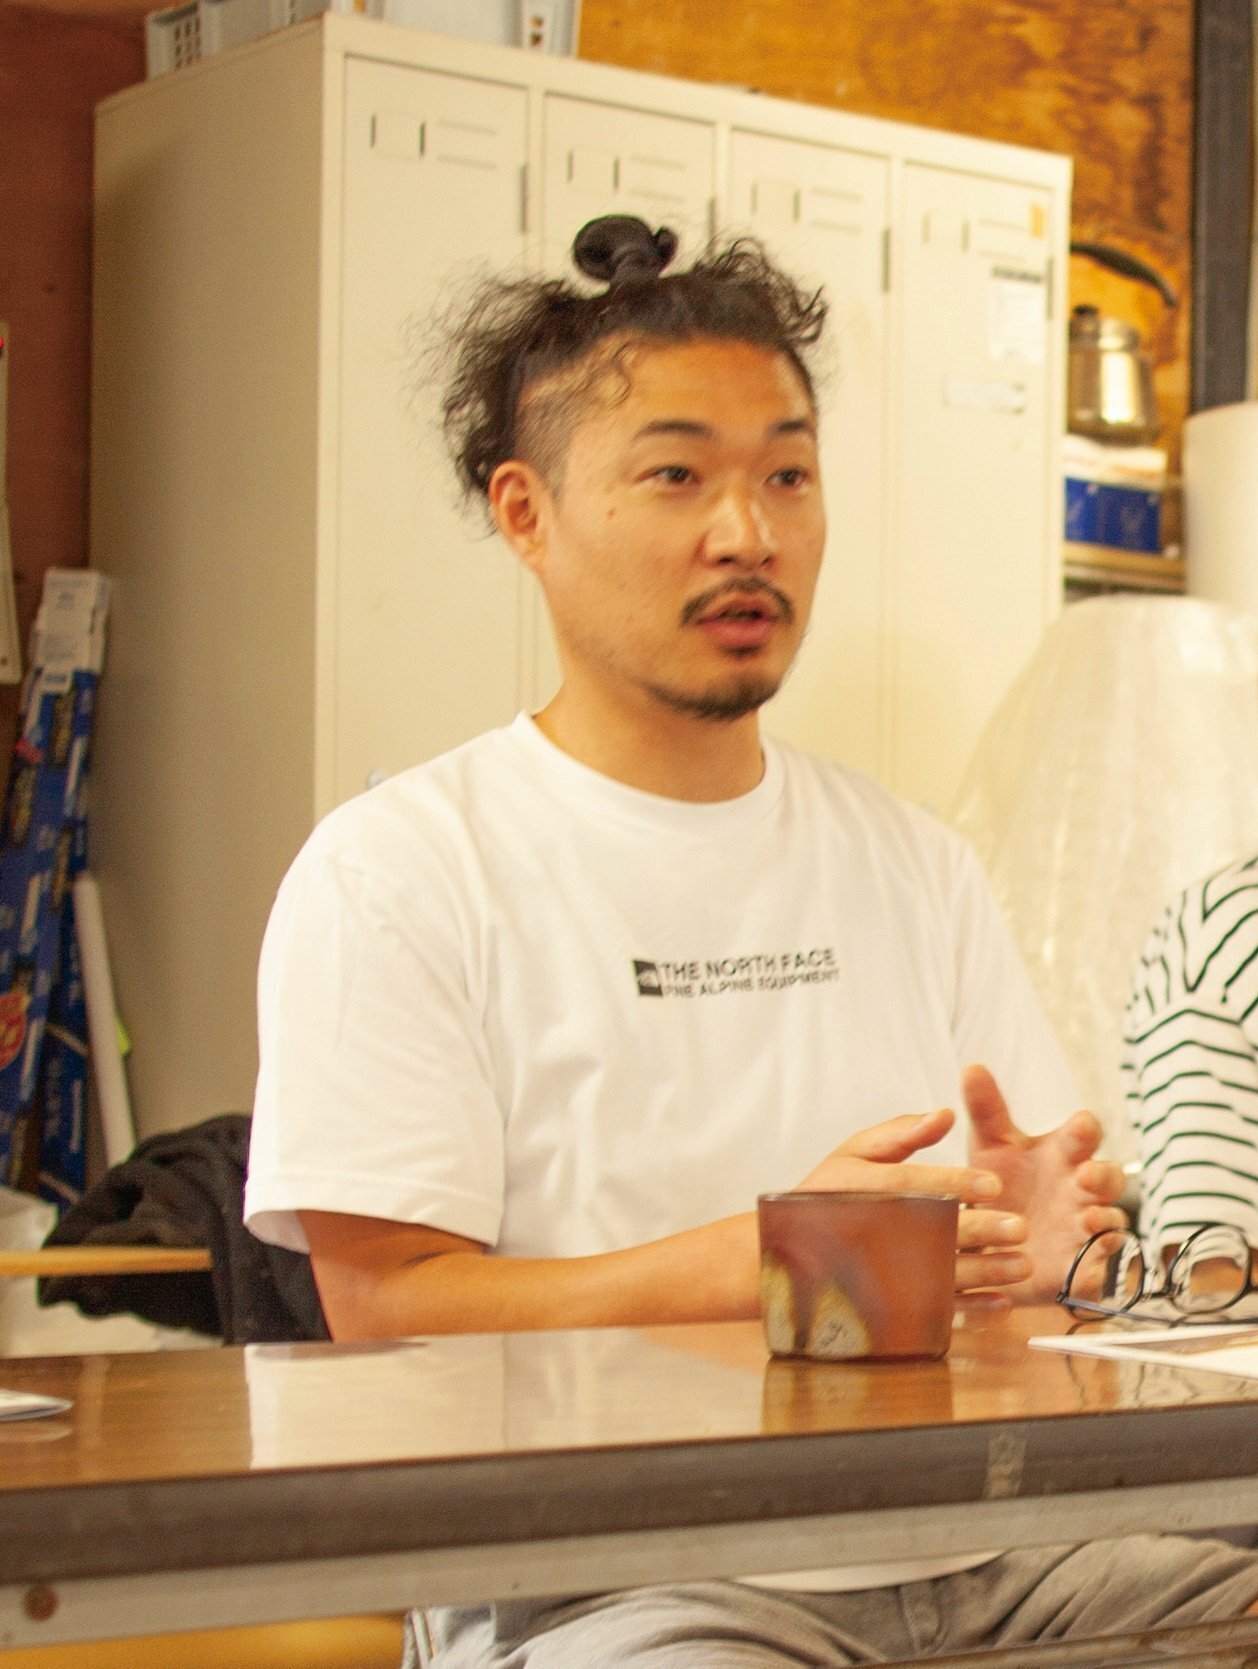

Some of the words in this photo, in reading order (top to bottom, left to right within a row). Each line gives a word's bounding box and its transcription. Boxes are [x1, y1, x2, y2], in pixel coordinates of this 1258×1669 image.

[663, 960, 700, 981] THE
[705, 954, 777, 977] NORTH
[781, 948, 837, 969] FACE
[699, 980, 754, 995] ALPINE
